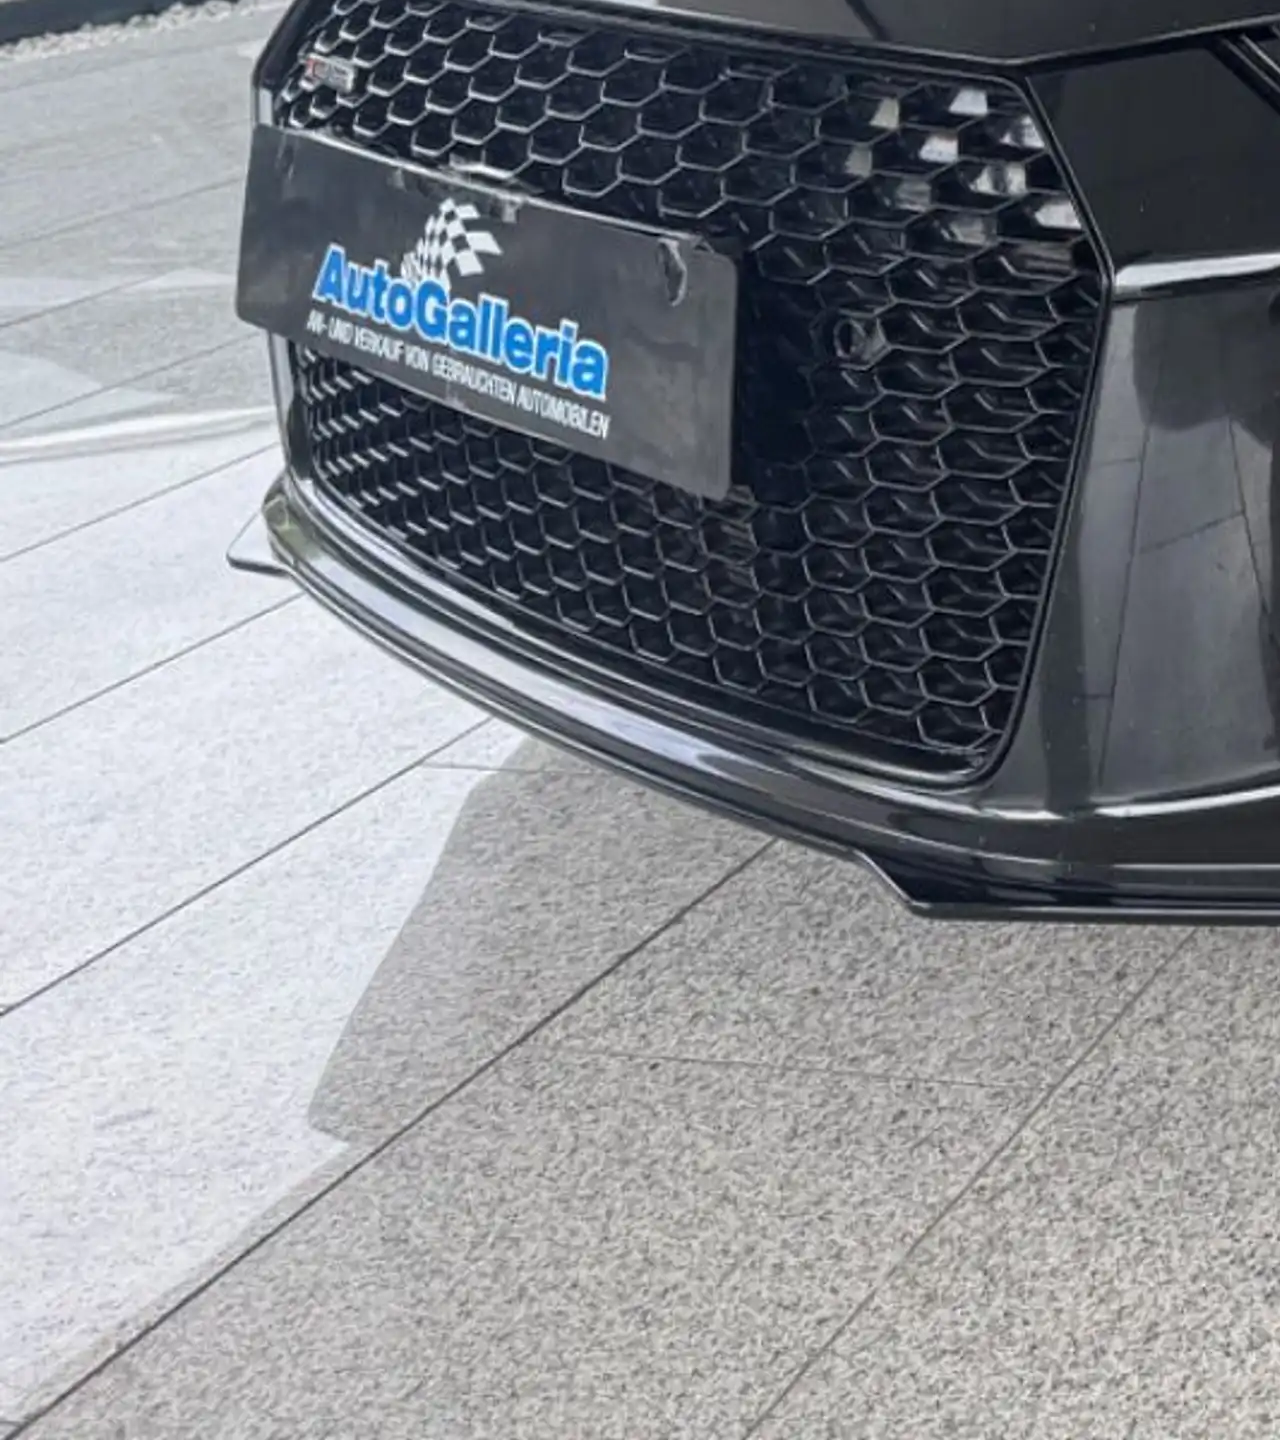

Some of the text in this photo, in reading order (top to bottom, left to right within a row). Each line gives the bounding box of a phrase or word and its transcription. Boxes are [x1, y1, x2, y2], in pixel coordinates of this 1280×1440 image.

[312, 242, 608, 402] AutoGalleria
[328, 317, 354, 345] UND
[355, 326, 404, 363] VERKAUF
[405, 343, 429, 372] VON
[432, 351, 517, 405] GEBRAUCHTEN
[517, 385, 611, 439] AUTOMOBILEN
